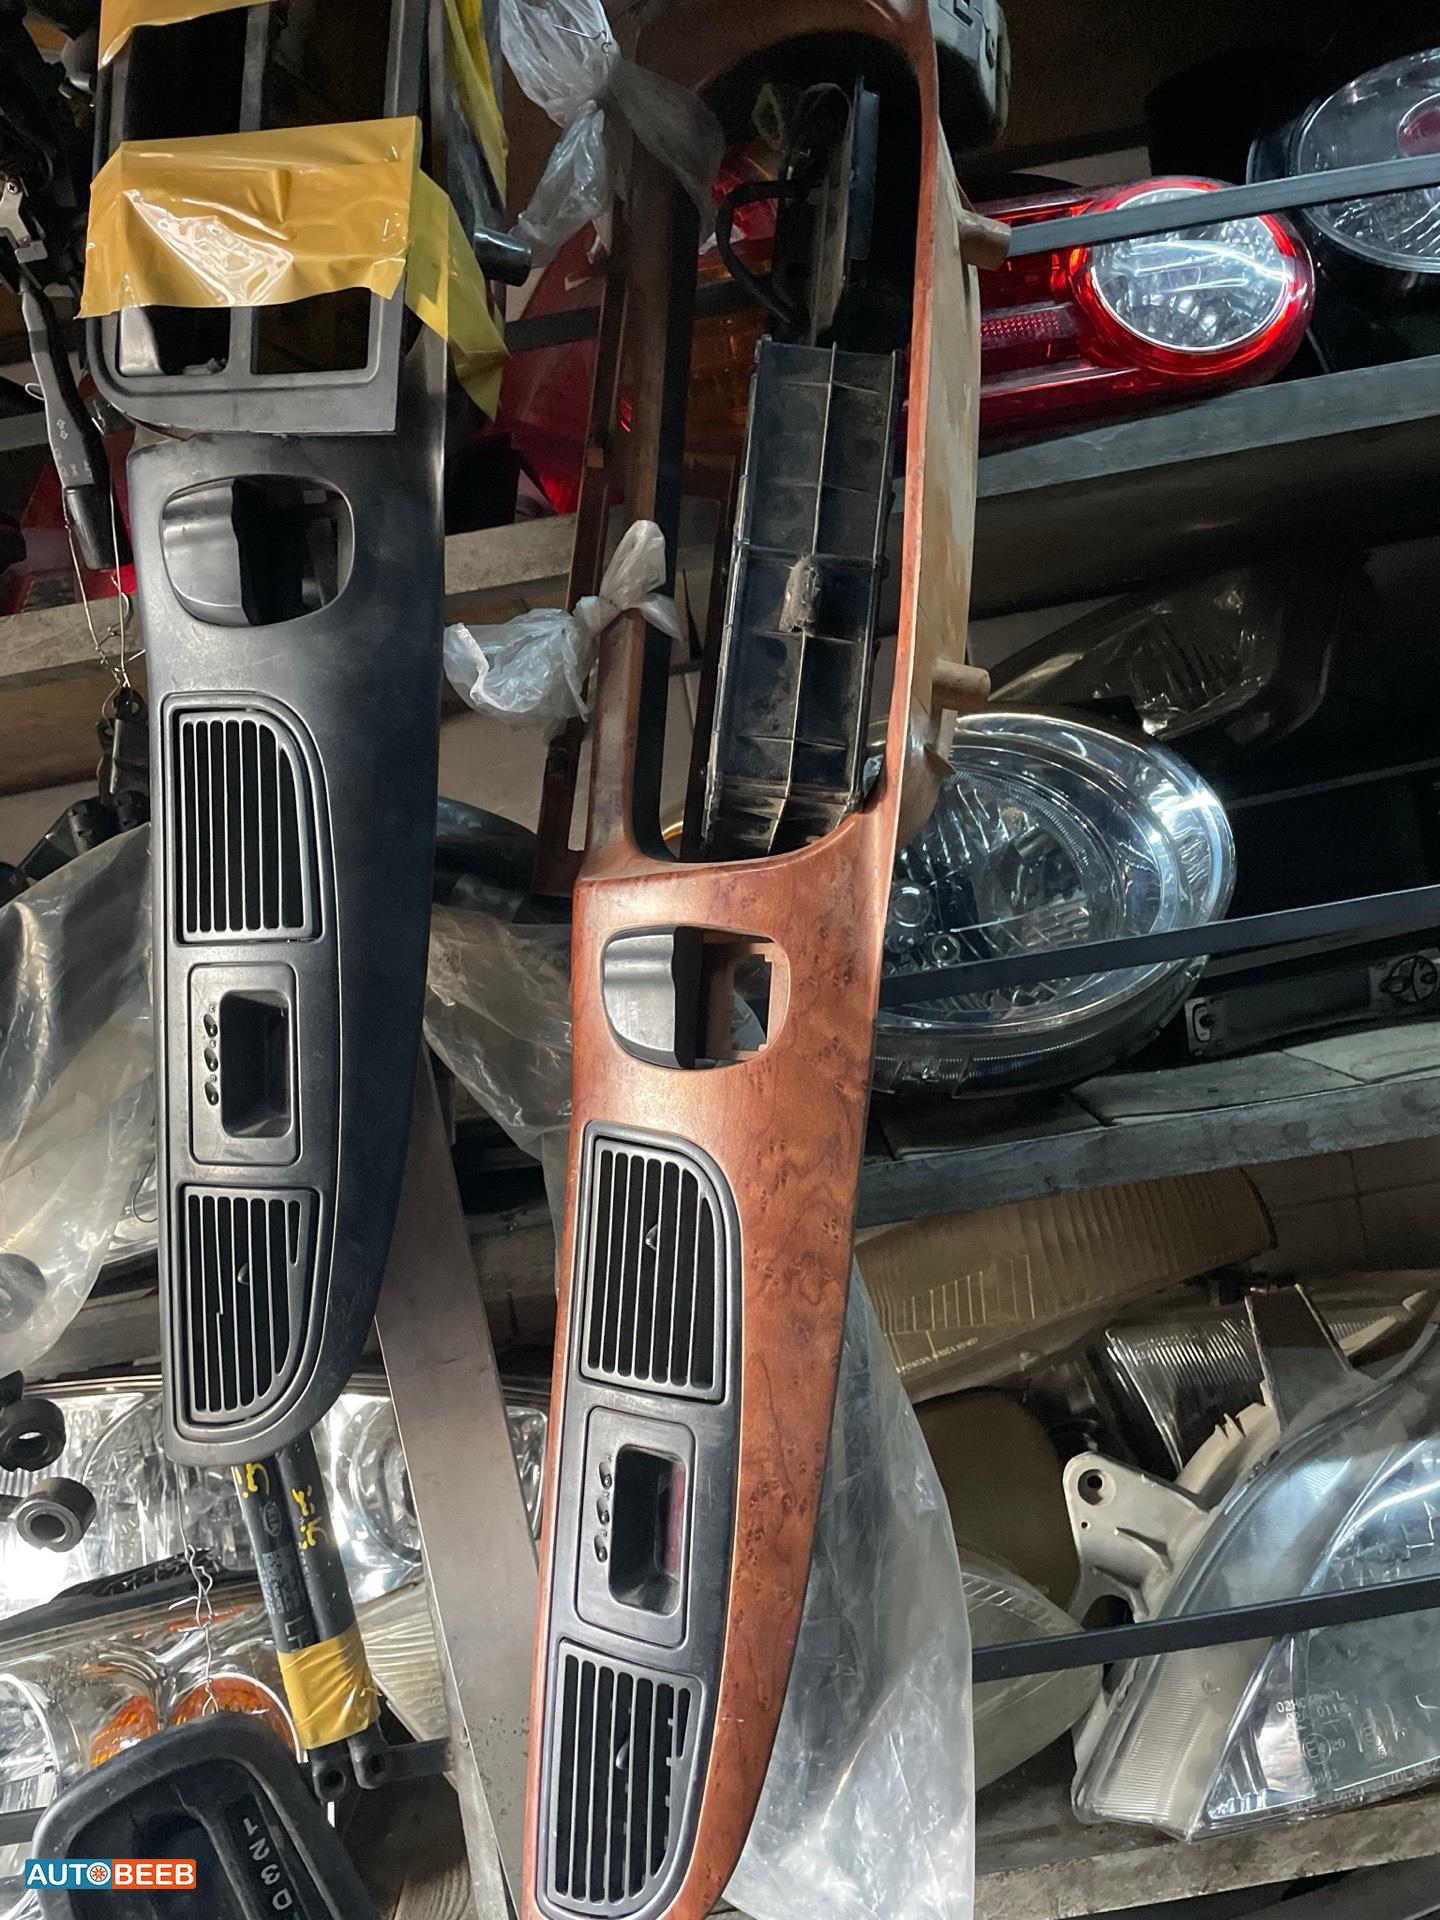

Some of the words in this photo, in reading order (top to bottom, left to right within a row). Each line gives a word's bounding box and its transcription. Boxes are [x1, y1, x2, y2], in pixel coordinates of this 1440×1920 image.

[243, 1817, 258, 1837] 1
[249, 1837, 270, 1861] 2
[260, 1863, 281, 1886] 3
[272, 1888, 293, 1911] D
